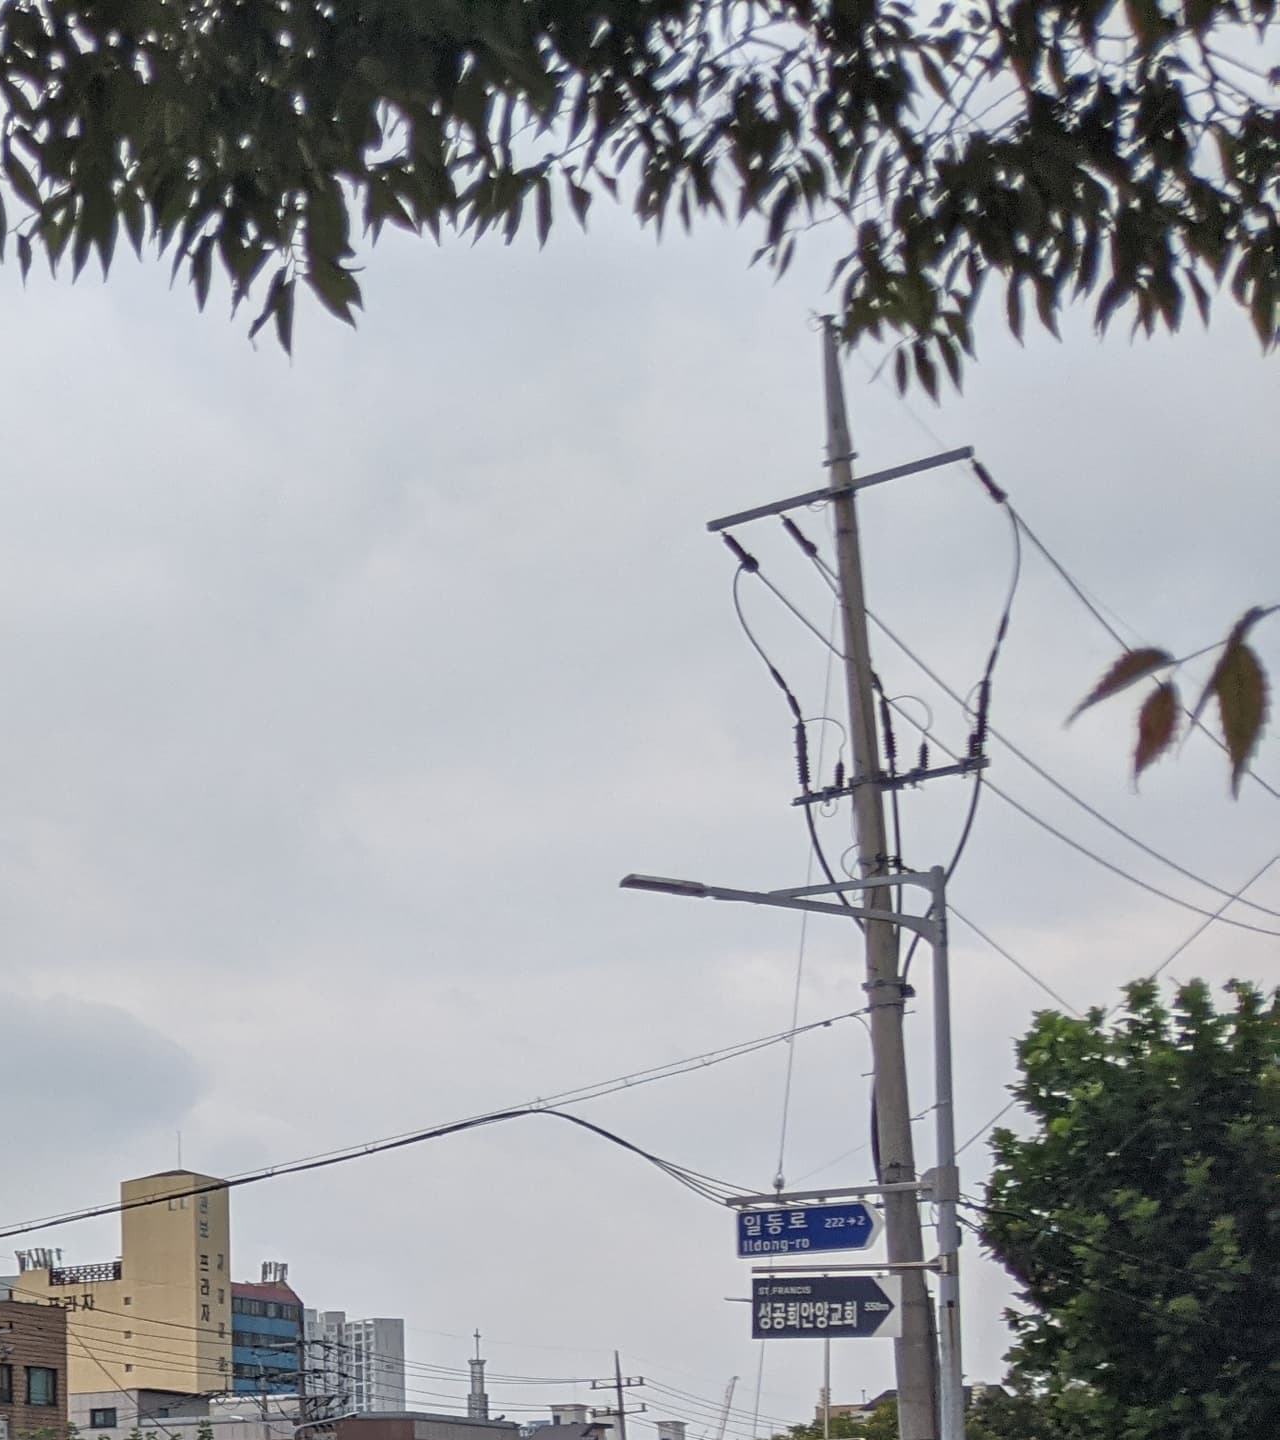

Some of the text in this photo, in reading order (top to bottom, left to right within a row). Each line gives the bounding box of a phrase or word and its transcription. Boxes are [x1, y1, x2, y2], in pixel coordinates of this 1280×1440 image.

[743, 1211, 866, 1237] 일동로 222 2
[743, 1238, 810, 1252] Ildong-ro
[759, 1300, 857, 1329] 성공회안양교회
